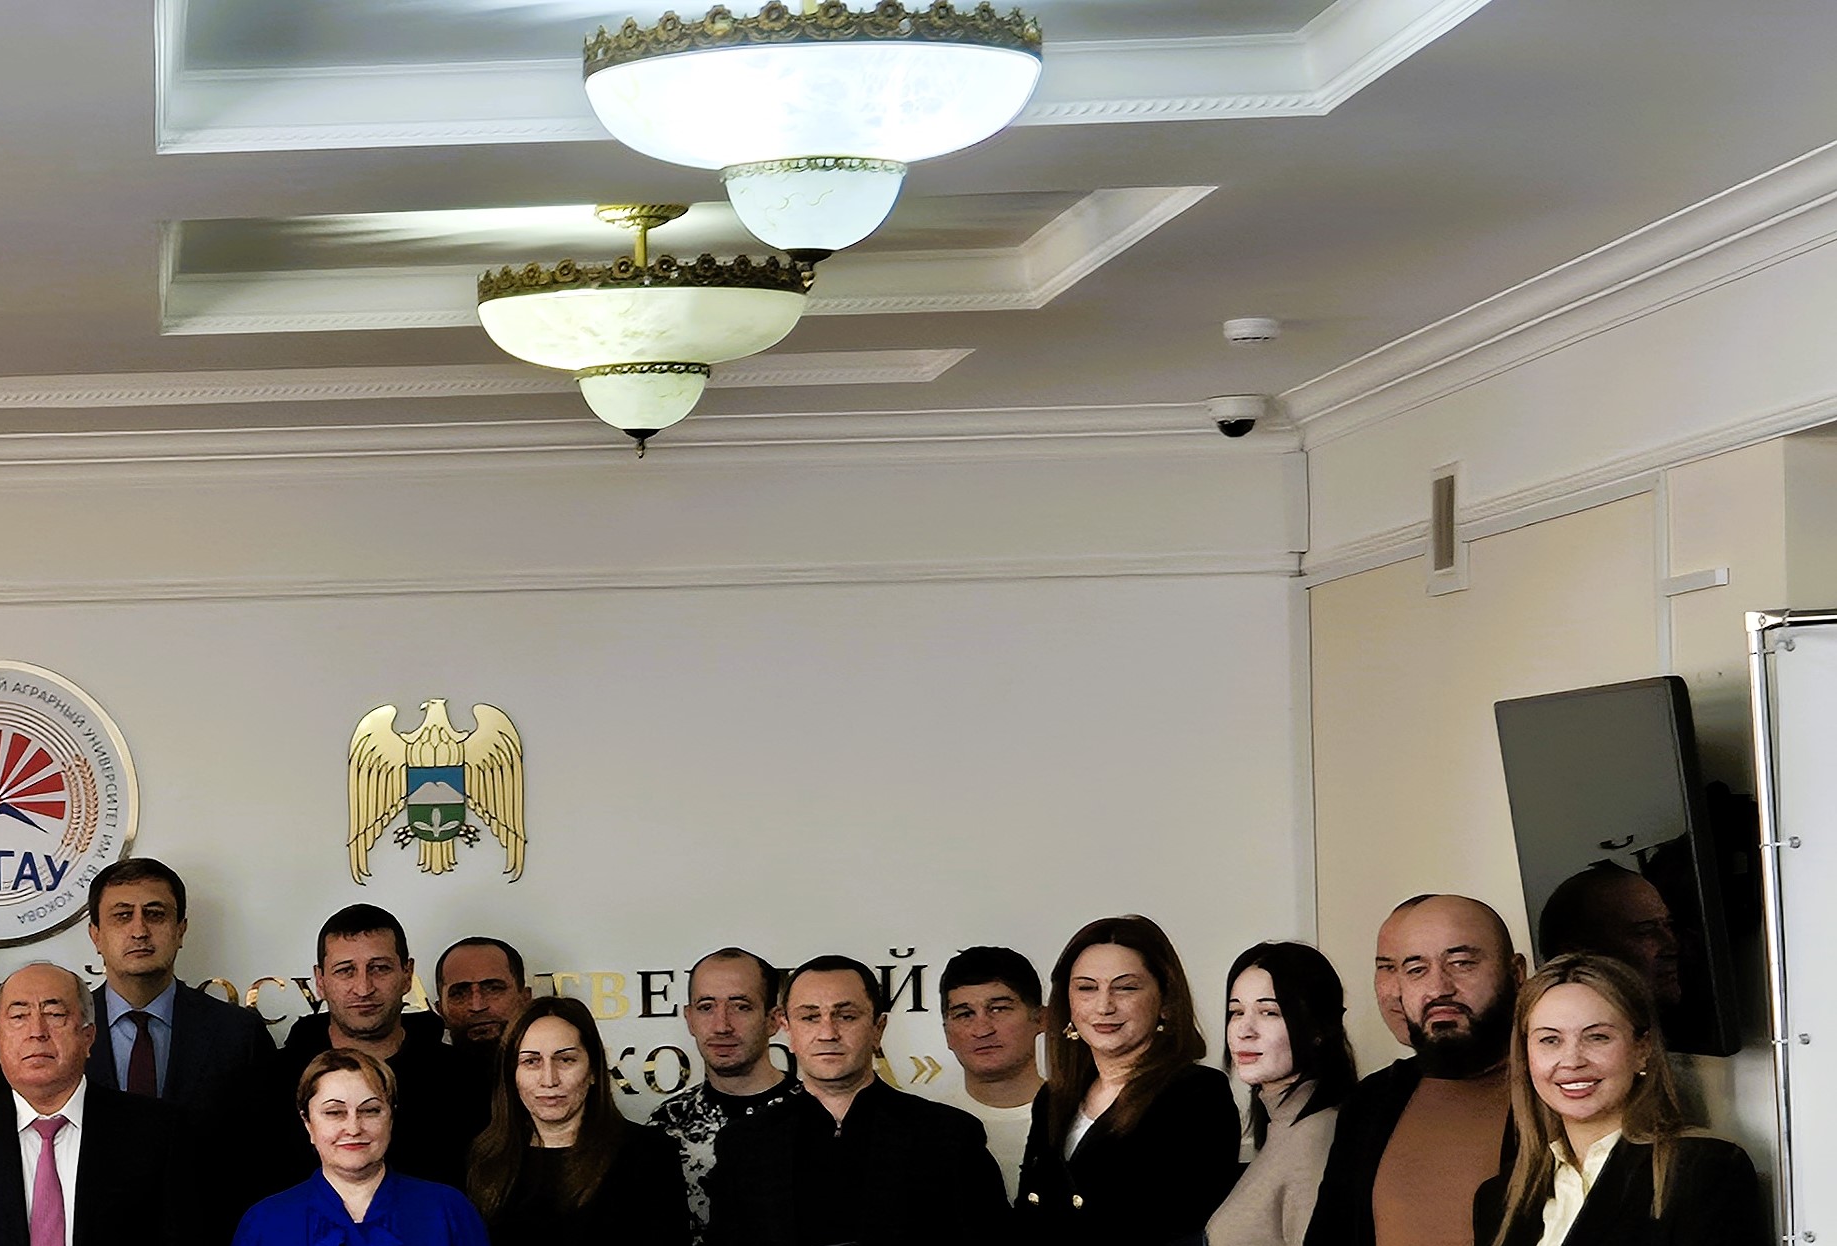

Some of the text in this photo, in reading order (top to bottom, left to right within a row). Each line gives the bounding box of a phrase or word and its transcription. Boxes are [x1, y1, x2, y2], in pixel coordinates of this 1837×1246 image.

[12, 681, 87, 729] АГРАРНЫЙ
[83, 727, 119, 828] УНИВЕРСИТЕТ
[17, 891, 74, 925] КОКОВА
